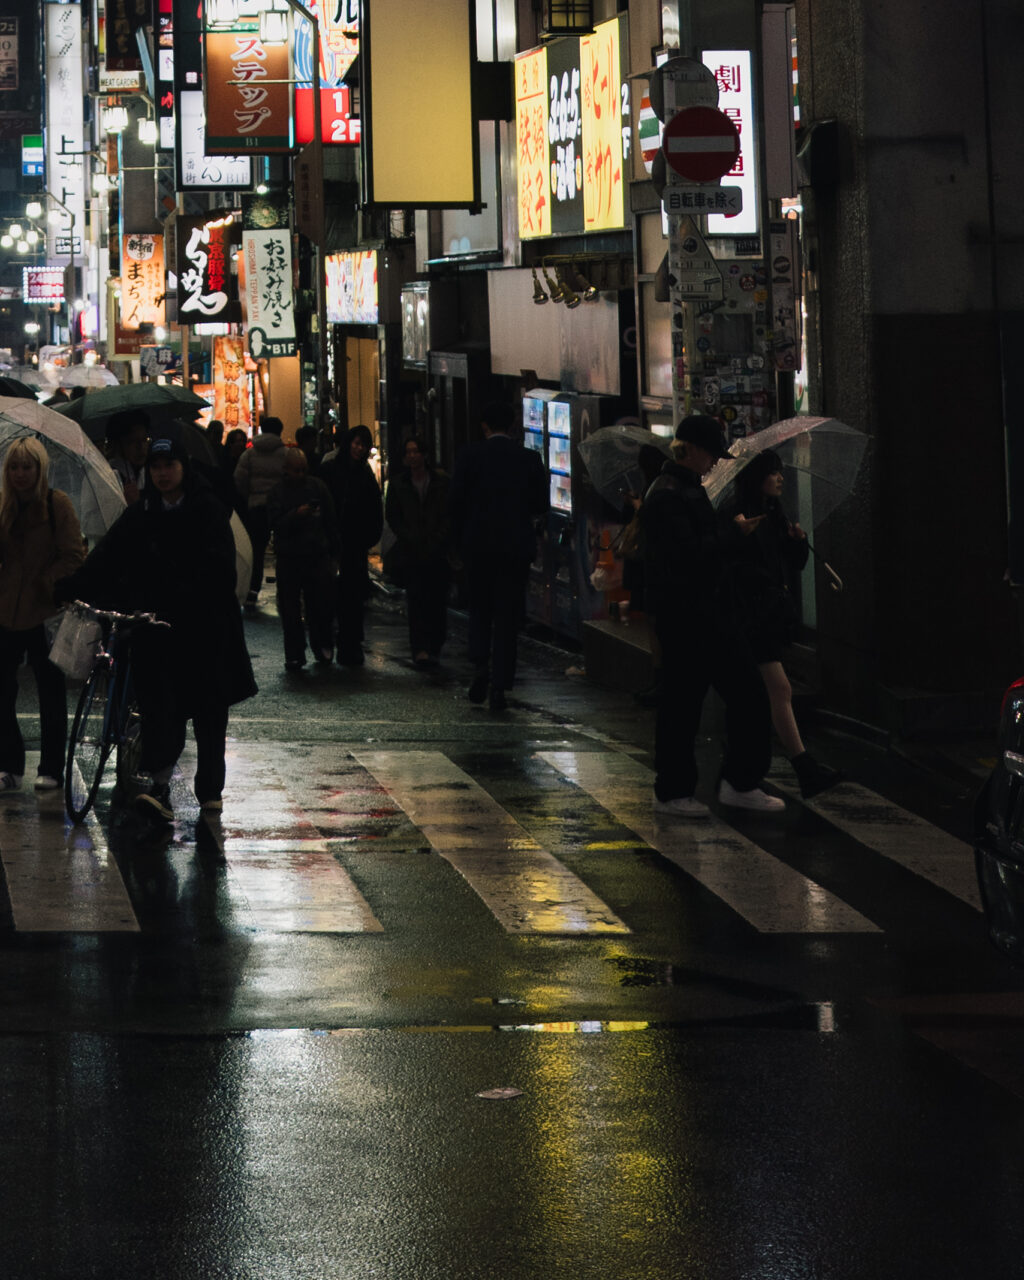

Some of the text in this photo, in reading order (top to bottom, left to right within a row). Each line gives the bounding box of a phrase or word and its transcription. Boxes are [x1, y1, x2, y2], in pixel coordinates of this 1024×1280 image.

[230, 36, 272, 133] ステップ
[331, 119, 362, 141] 2F
[669, 192, 737, 209] 自転車を除く
[260, 238, 292, 328] お好み焼き
[272, 343, 295, 355] B1F
